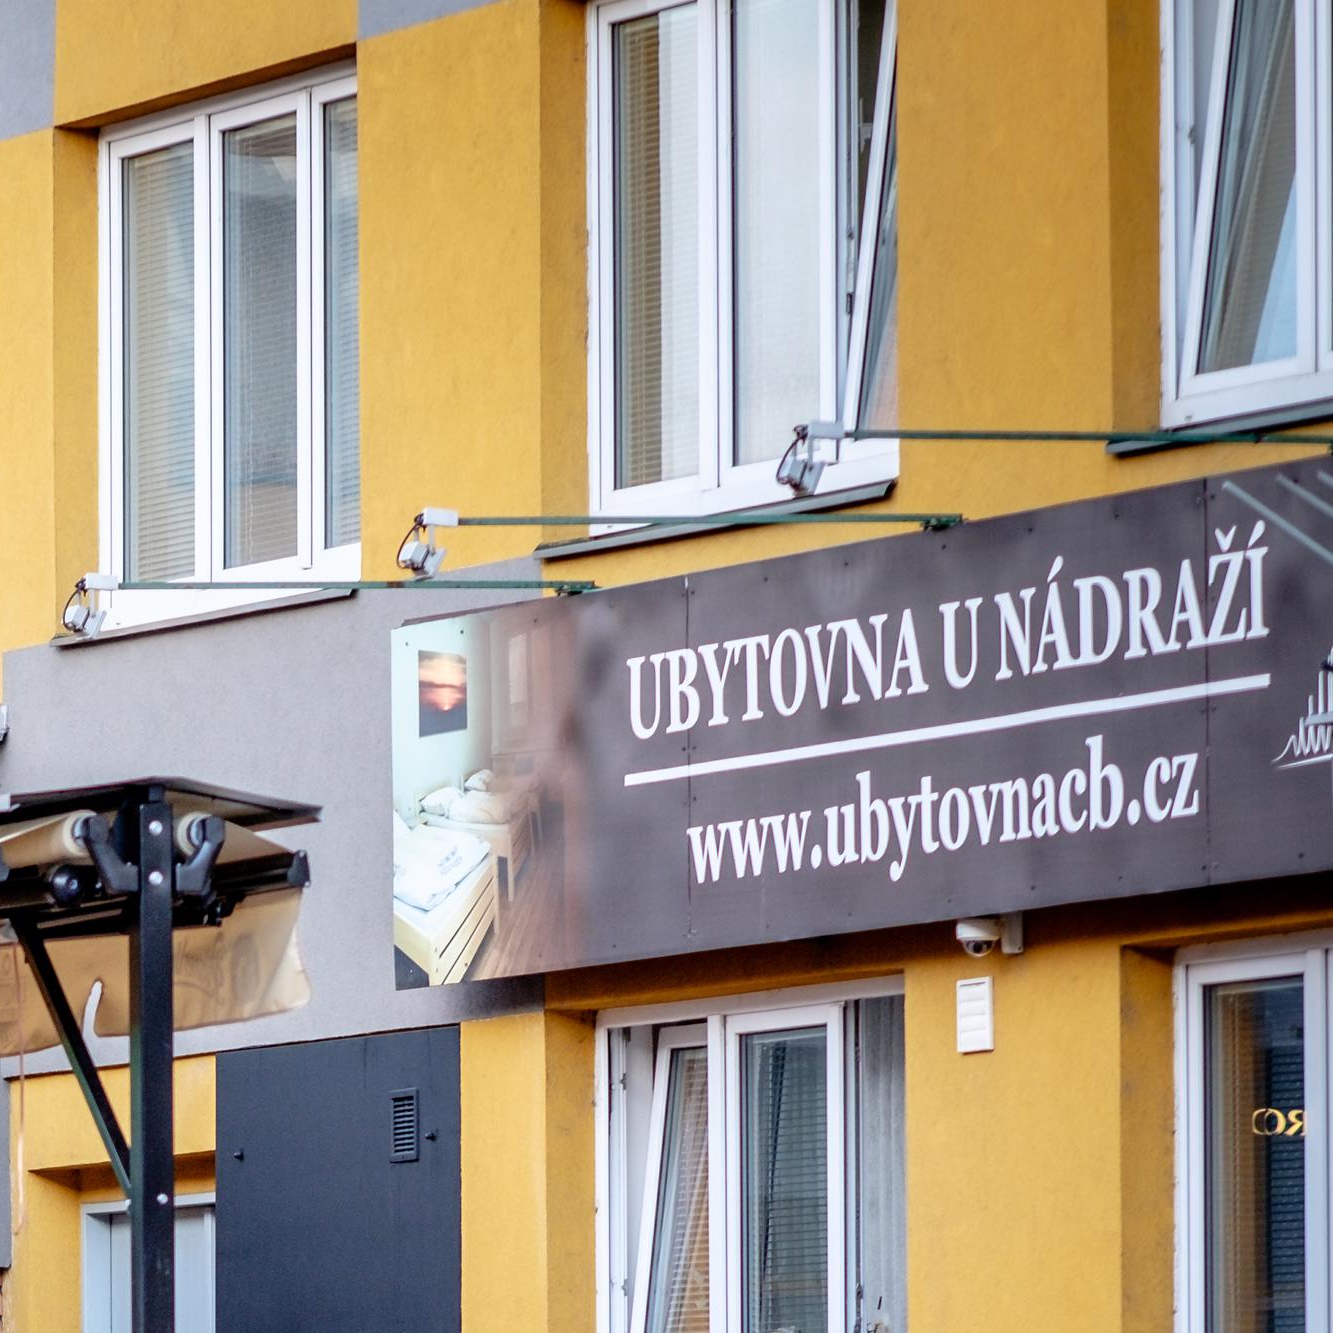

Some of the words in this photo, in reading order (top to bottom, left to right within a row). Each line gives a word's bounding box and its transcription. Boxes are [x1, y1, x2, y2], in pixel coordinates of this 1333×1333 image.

[626, 607, 930, 740] UBYTOVNA
[938, 596, 983, 690] U
[994, 520, 1270, 681] NÁDRAŽÍ
[686, 734, 1200, 884] www.ubytovnacb.cz
